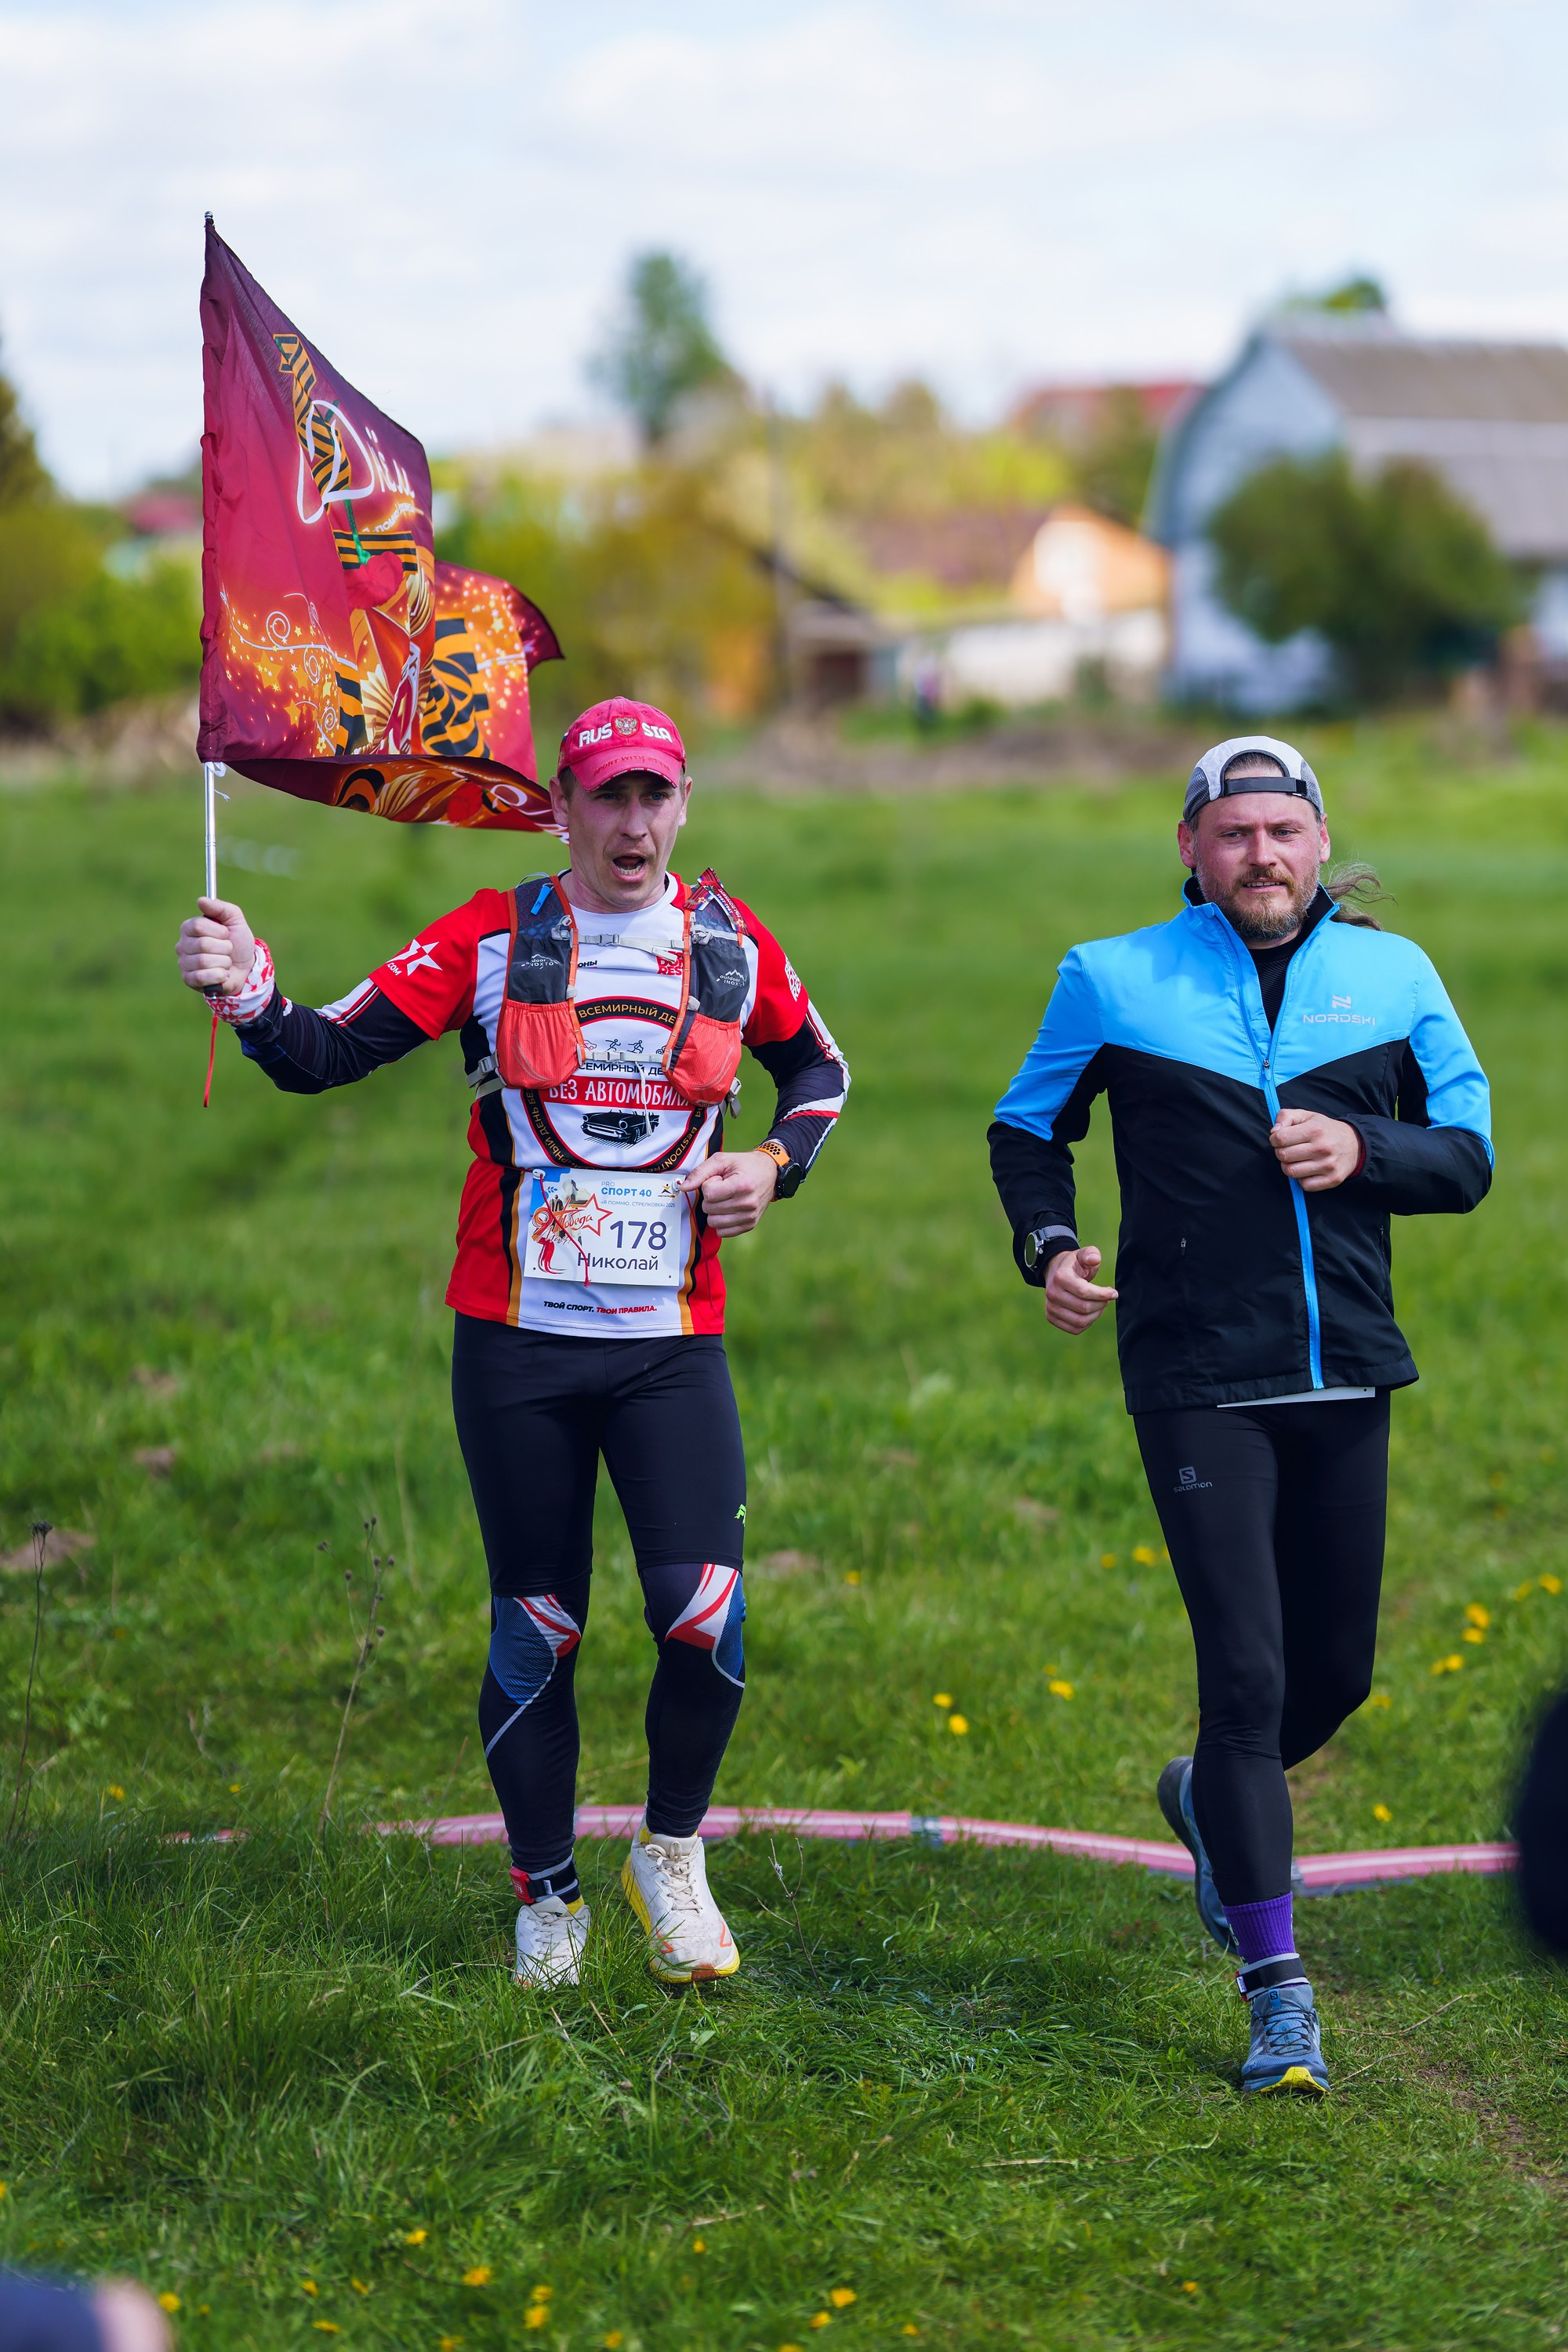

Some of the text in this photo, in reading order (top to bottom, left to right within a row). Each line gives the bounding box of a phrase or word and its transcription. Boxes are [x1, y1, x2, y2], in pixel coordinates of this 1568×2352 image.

[579, 1004, 658, 1018] ВСЕМИРНЫЙ
[1303, 1014, 1375, 1025] NORDSKI
[601, 1187, 637, 1196] СПОРТ
[610, 1220, 667, 1250] 178
[577, 1252, 659, 1271] Николай
[543, 1301, 565, 1309] ТВОЙ
[566, 1304, 594, 1312] СПОРТ.
[619, 1305, 658, 1314] ПРАВИЛА.
